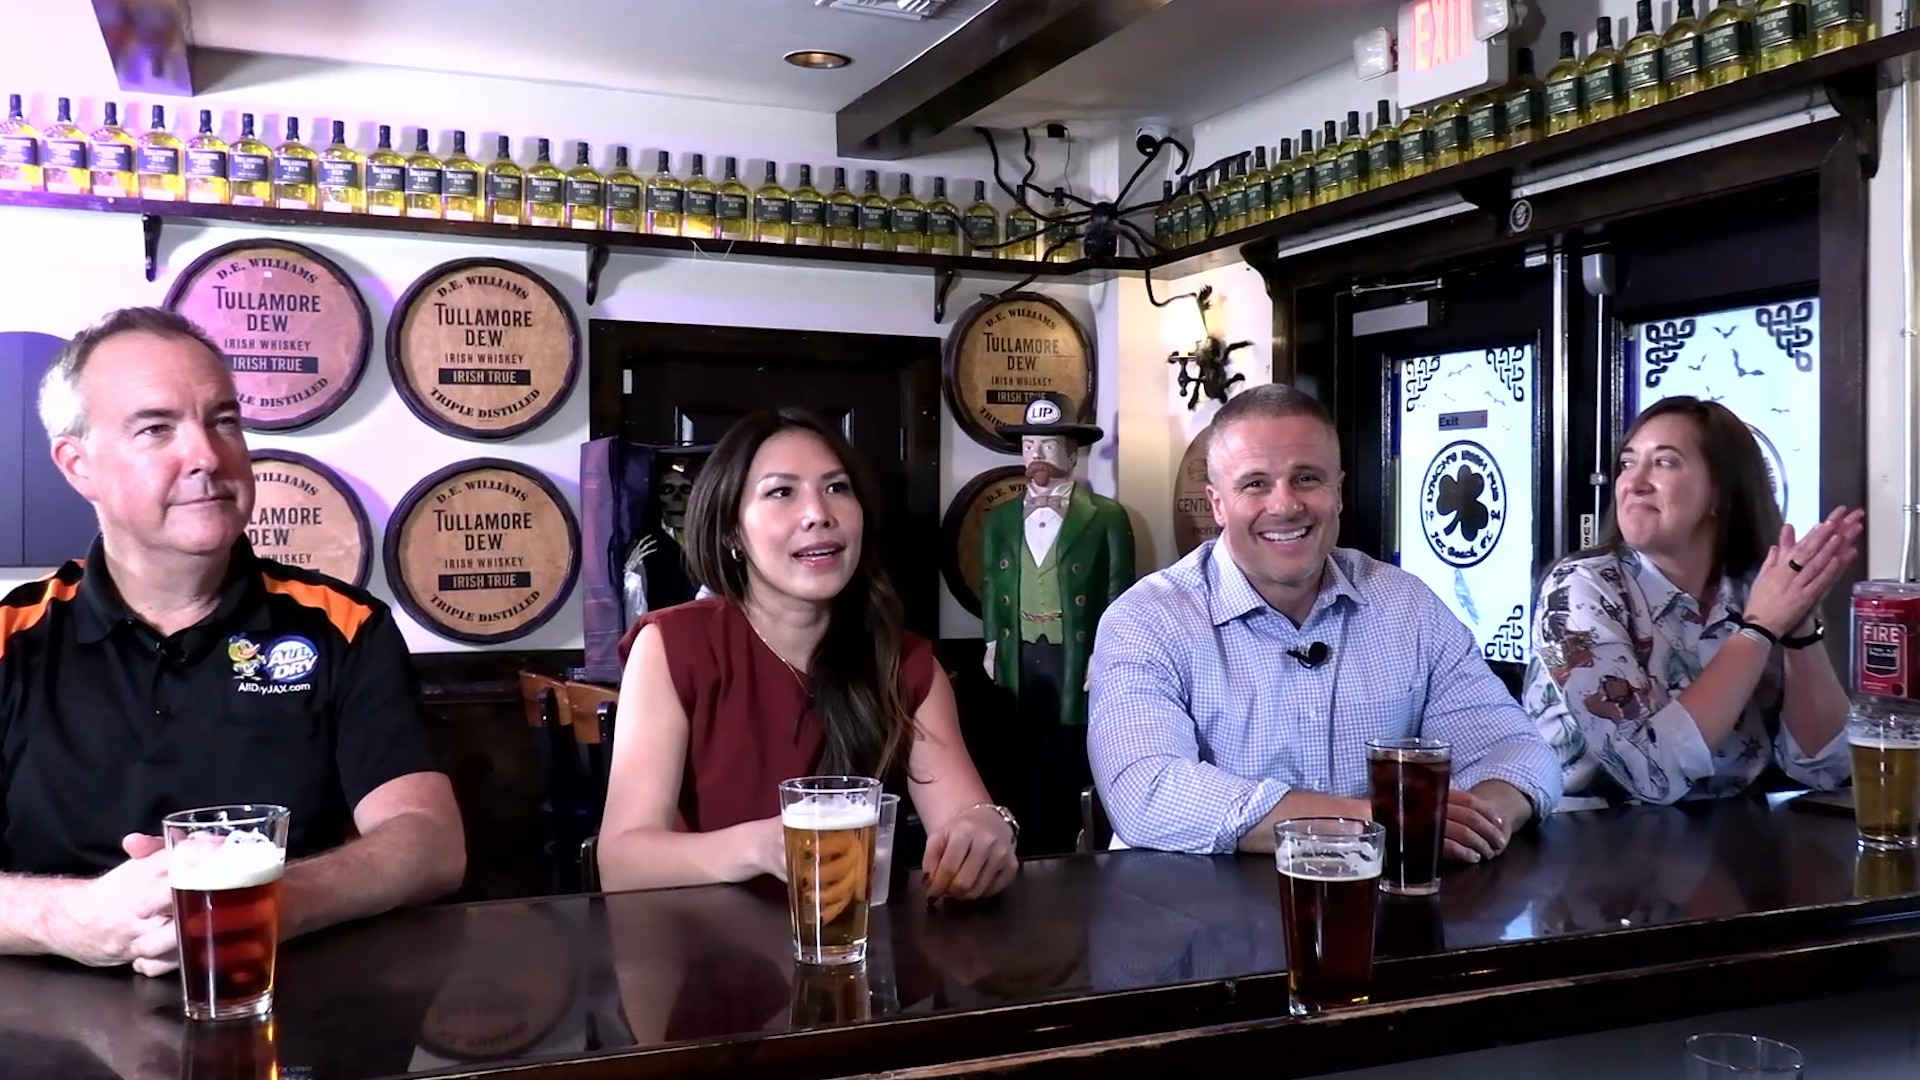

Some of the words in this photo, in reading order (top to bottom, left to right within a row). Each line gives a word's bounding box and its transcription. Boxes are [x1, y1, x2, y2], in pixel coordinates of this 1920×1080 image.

[248, 258, 318, 284] WILLIAMS
[465, 275, 529, 300] WILLIAMS
[213, 286, 321, 312] TULLAMORE
[434, 303, 533, 327] TULLAMORE
[224, 338, 255, 349] IRISH
[259, 340, 311, 351] WHISKEY
[983, 332, 1059, 354] TULLAMORE
[233, 357, 267, 371] IRISH
[272, 358, 303, 371] TRUE
[445, 353, 473, 364] IRISH
[477, 354, 525, 364] WHISKEY
[453, 370, 485, 383] IRISH
[488, 371, 517, 384] TRUE
[260, 378, 328, 407] DISTILLED
[430, 387, 475, 417] TRIPLE
[478, 388, 540, 418] DISTILLED
[998, 391, 1021, 402] IRISH
[1032, 407, 1053, 418] LIP
[465, 480, 529, 502] WILLIAMS
[1177, 498, 1214, 513] CENTU
[433, 509, 532, 532] TULLAMORE
[1583, 516, 1591, 550] PUS
[445, 558, 473, 569] IRISH
[477, 556, 524, 568] WHISKEY
[452, 576, 485, 588] IRISH
[488, 574, 517, 587] TRUE
[430, 594, 474, 621] TRIPLE
[478, 590, 540, 622] DISTILLED
[1863, 625, 1899, 642] FIRE
[272, 655, 318, 679] DRY
[238, 682, 311, 696] AllDyJAX.com
